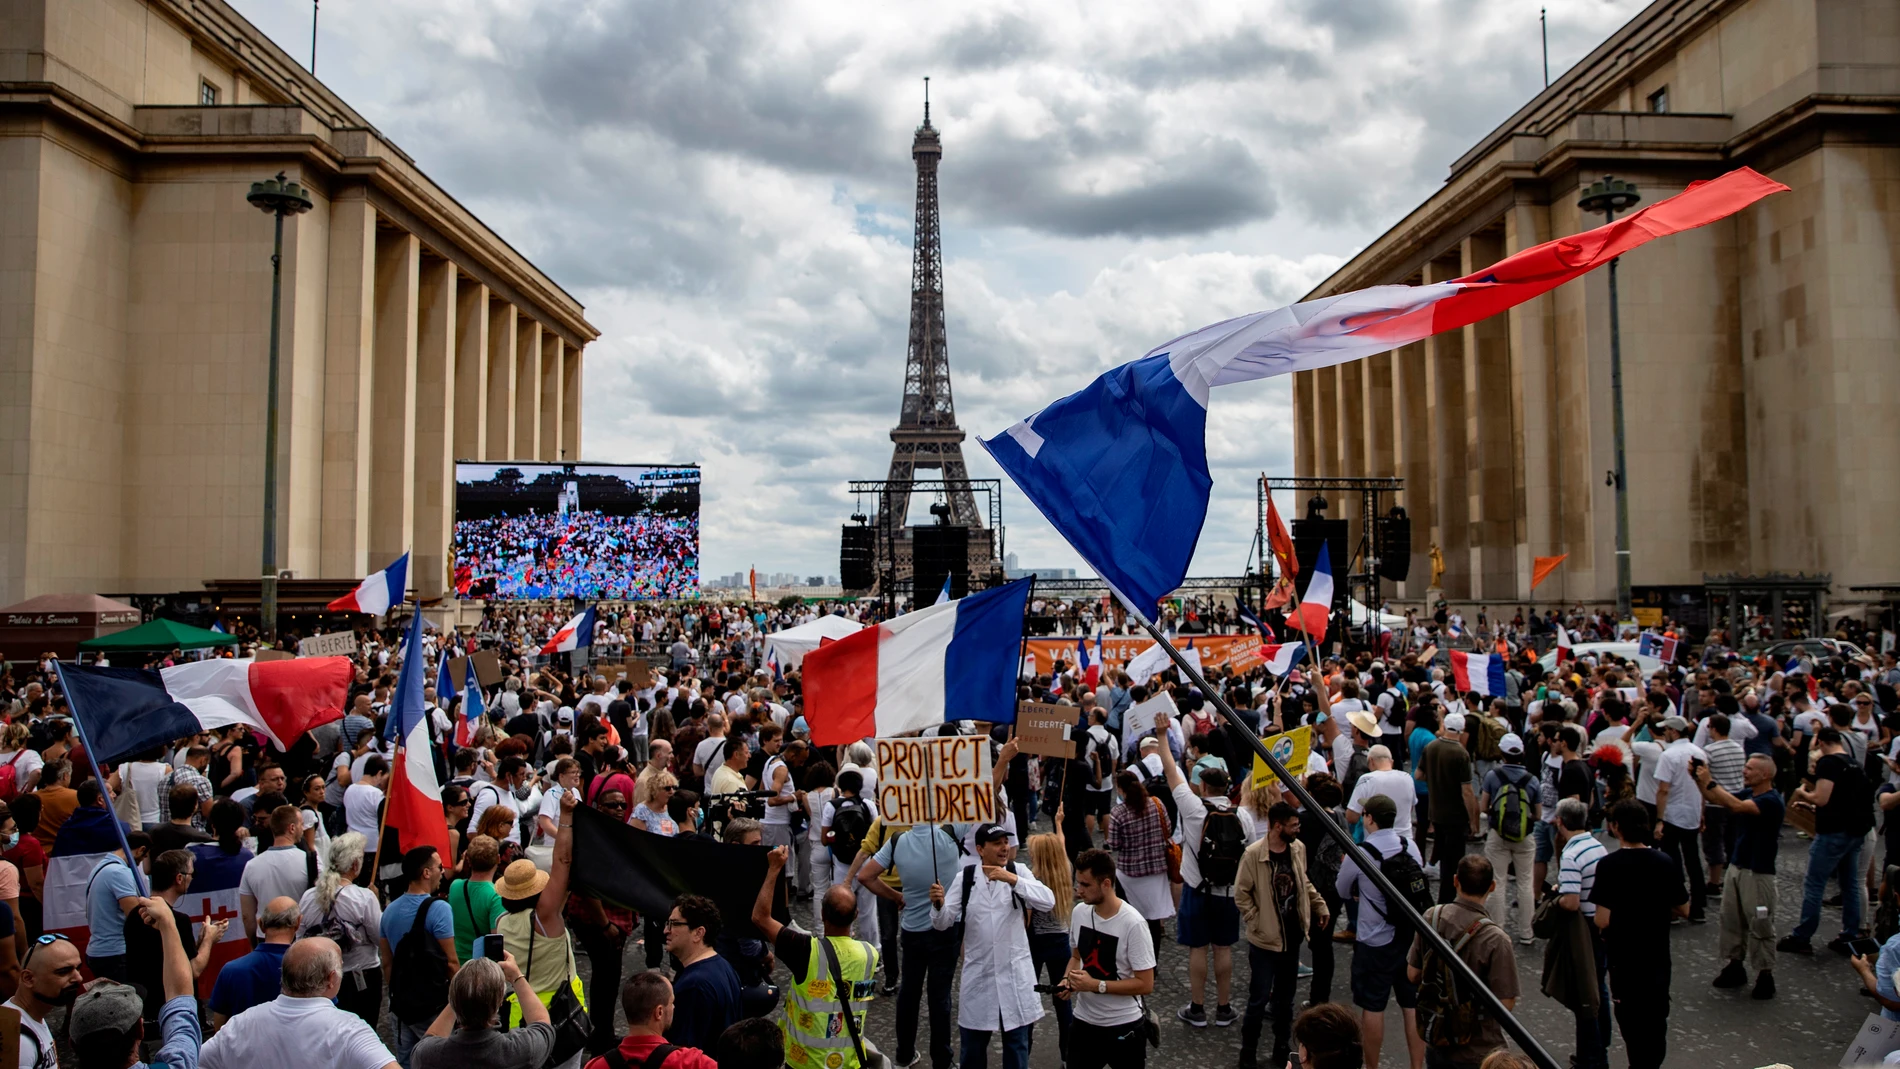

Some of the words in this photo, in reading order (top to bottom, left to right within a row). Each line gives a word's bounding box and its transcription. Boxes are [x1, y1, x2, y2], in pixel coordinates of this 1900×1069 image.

[8, 614, 32, 625] Palais
[35, 615, 43, 624] de
[46, 614, 79, 624] Souvenir
[307, 633, 353, 656] LIBERTÉ
[1231, 642, 1248, 655] NON
[1248, 637, 1259, 649] AU
[1029, 719, 1066, 729] LIBERTÉ
[1020, 734, 1049, 743] IBERTÉ
[877, 738, 986, 781] PROTECT
